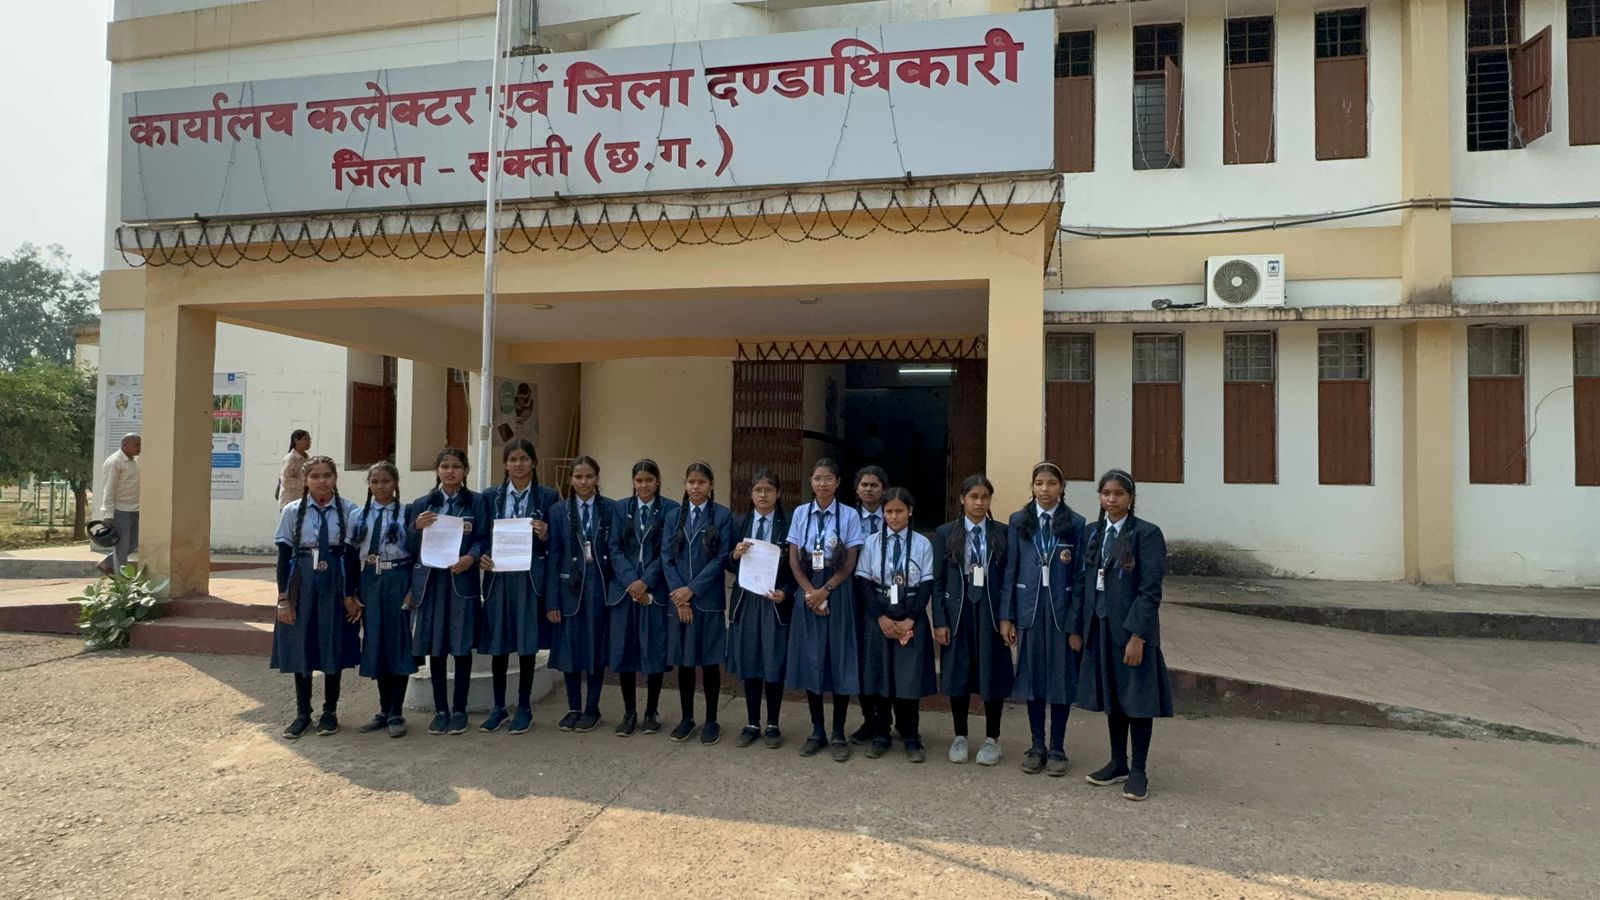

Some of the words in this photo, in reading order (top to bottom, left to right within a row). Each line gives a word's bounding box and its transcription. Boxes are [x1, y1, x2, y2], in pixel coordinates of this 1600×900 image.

[128, 92, 298, 148] कार्यालय
[306, 82, 477, 134] कलेक्टर
[563, 61, 695, 115] जिला
[705, 28, 1025, 108] दण्डाधिकारी
[332, 148, 425, 191] जिला
